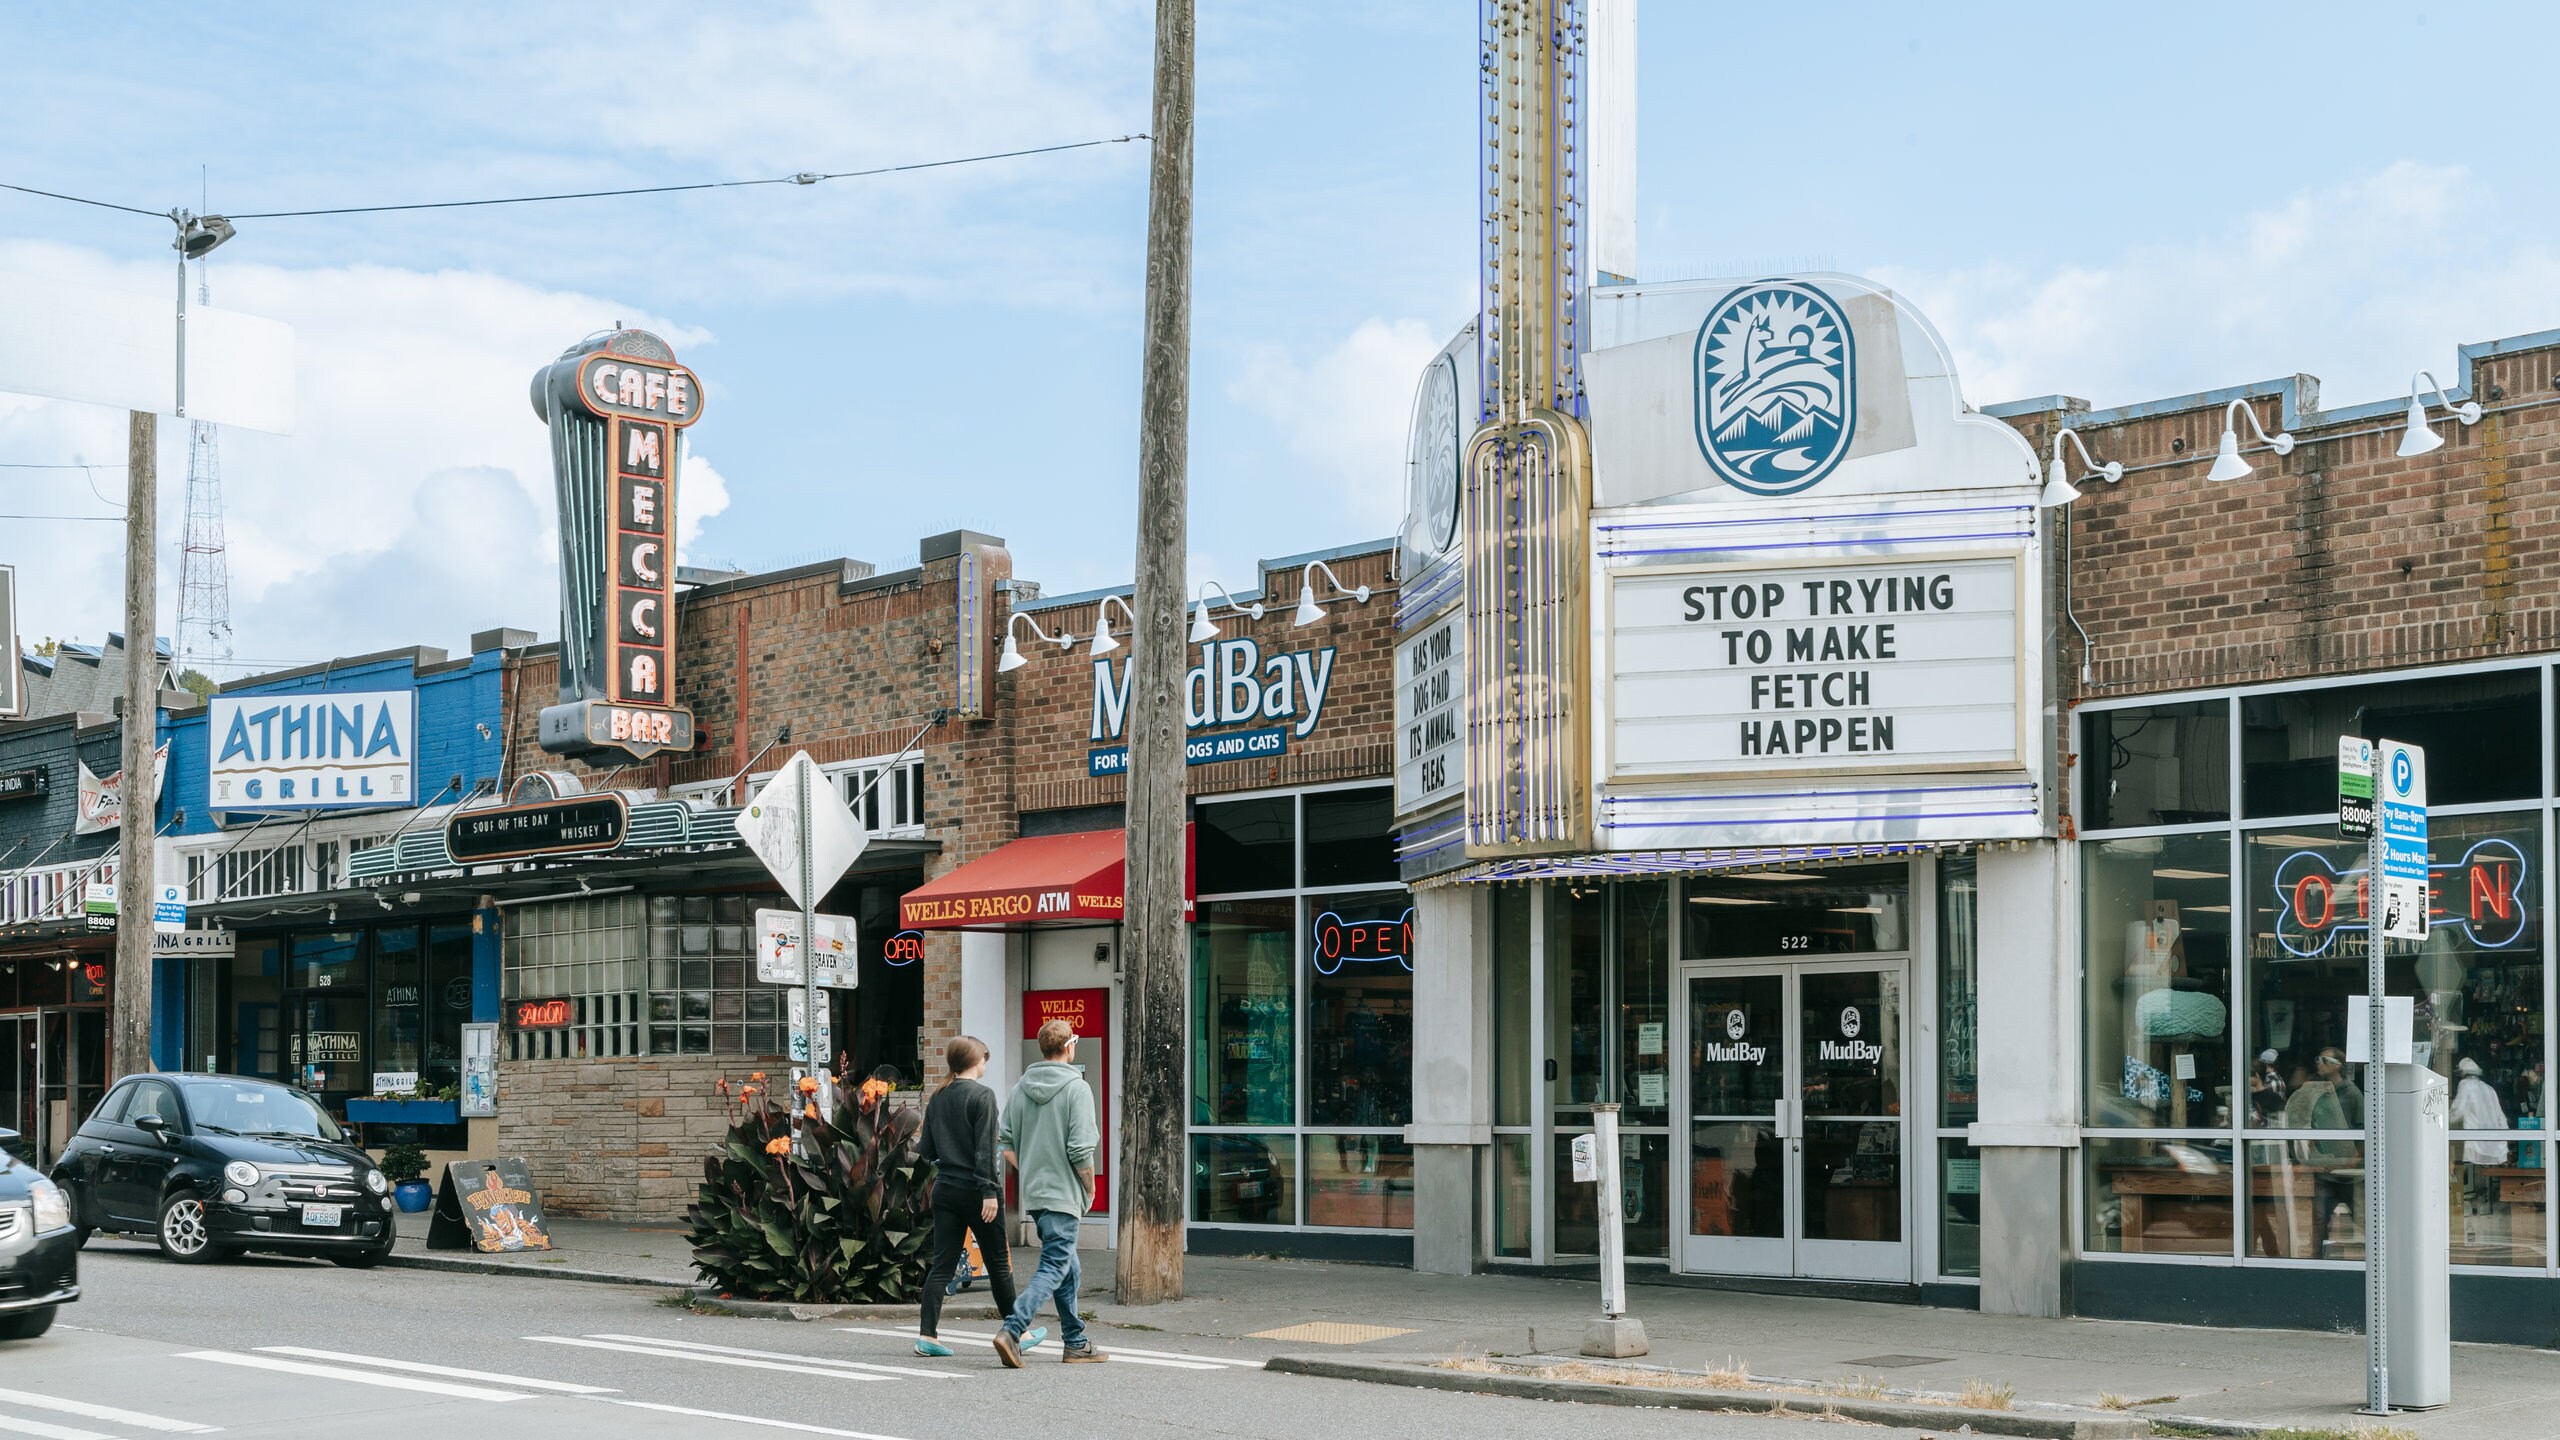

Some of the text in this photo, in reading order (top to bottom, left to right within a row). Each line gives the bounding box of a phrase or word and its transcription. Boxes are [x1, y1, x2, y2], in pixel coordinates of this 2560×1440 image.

[593, 364, 688, 415] CAFÉ
[627, 428, 661, 694] MECCA
[1683, 574, 1954, 622] STOP TRYING
[1412, 624, 1452, 678] HAS YOUR
[1721, 623, 1896, 665] TO MAKE
[1090, 637, 1337, 741] MdBay
[1413, 668, 1450, 718] DOG PAID
[1750, 670, 1870, 710] FETCH
[217, 698, 401, 764] ATHINA
[610, 708, 672, 745] BAR
[1409, 707, 1456, 760] ITS ANNUAL
[1740, 716, 1895, 756] HAPPEN
[1094, 754, 1118, 770] FOR
[1187, 741, 1213, 759] OGS
[1216, 738, 1245, 756] AND
[1248, 733, 1280, 751] CATS
[5, 777, 22, 791] INDIA
[1421, 754, 1446, 795] FLEAS
[244, 775, 374, 800] GRILL
[498, 818, 510, 831] OF
[513, 816, 529, 829] THE
[532, 813, 550, 828] DAY
[2342, 806, 2371, 824] 88008
[2383, 805, 2425, 825] Pay 8am-8pm
[560, 825, 600, 840] WHISKEY
[2383, 841, 2426, 865] 2 Hours Max
[904, 891, 1070, 922] WELLS FARGO ATM
[1077, 895, 1123, 909] WELLS
[87, 916, 116, 926] 88008
[154, 933, 231, 949] INA GRILL
[884, 937, 925, 960] OPEN
[1781, 935, 1808, 949] 522
[85, 963, 105, 985] ROTI
[319, 974, 332, 987] 528
[386, 986, 418, 1003] ATHINA
[1040, 999, 1085, 1014] WELLS
[518, 1001, 565, 1026] SALOON
[1041, 1015, 1085, 1029] FGO
[313, 1034, 358, 1050] ATHINA
[1706, 1042, 1766, 1066] MudBay
[1819, 1040, 1883, 1065] MudBay
[375, 1076, 395, 1087] ATHINA
